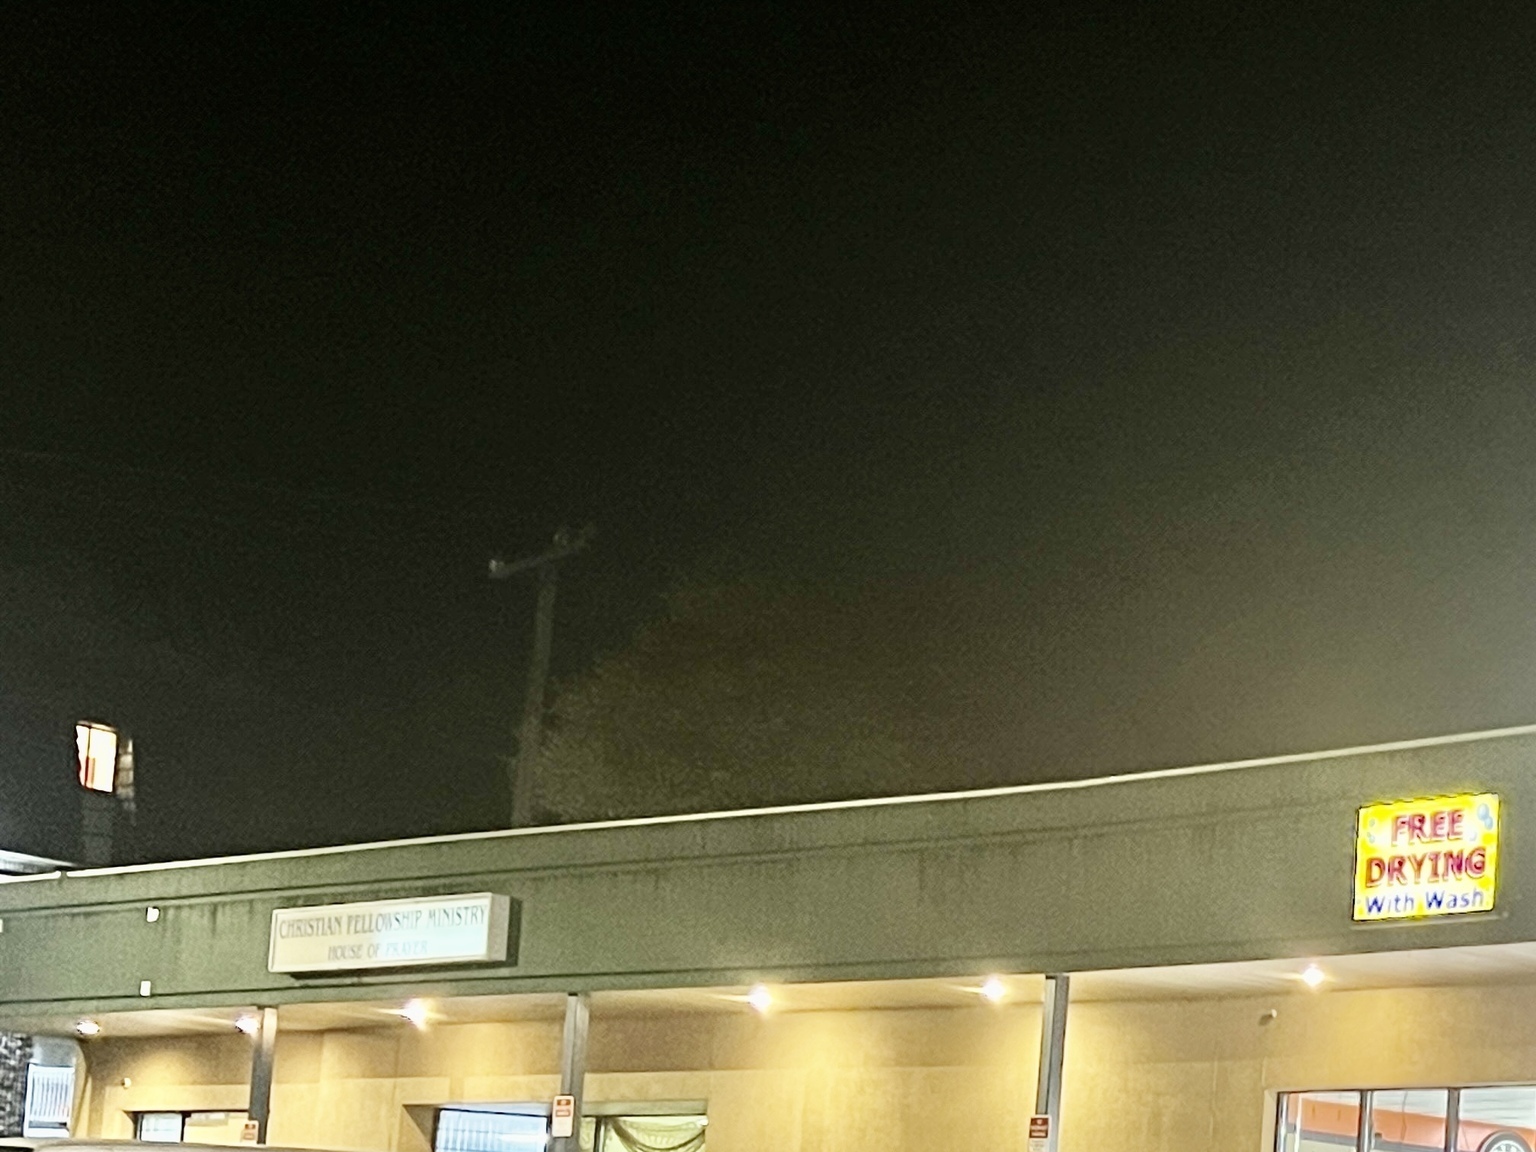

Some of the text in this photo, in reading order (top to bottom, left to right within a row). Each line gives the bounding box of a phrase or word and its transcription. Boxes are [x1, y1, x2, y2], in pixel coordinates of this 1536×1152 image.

[1390, 809, 1465, 847] FREE
[1365, 847, 1487, 889] DRYING
[1366, 887, 1485, 915] With Wash
[279, 904, 488, 940] CHRISTIAN FELLOWSHIP MINISTRY
[327, 940, 428, 961] HOUSE OF PRAYER
